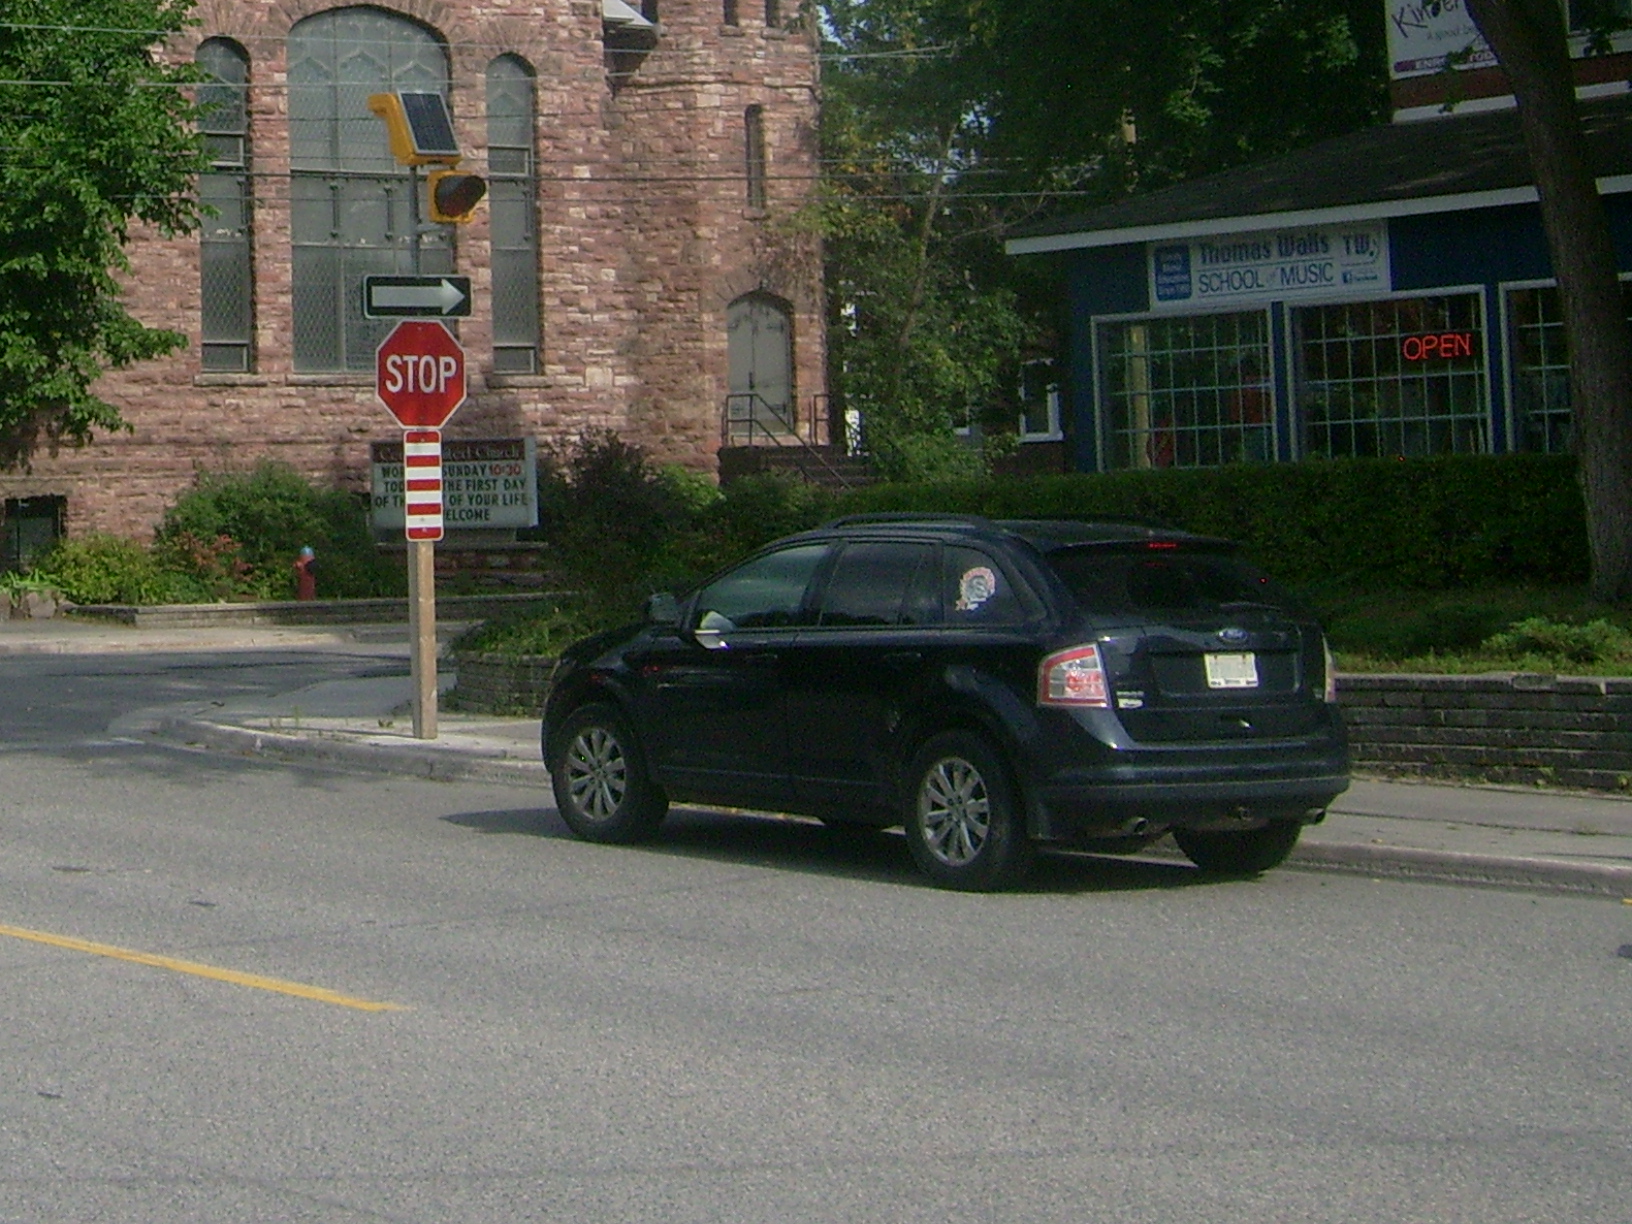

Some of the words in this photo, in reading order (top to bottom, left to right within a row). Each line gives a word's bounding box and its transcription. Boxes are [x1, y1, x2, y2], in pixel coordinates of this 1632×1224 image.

[1198, 268, 1265, 293] SCHOOL
[1280, 262, 1334, 286] MUSIC
[1402, 332, 1472, 361] OPEN
[385, 353, 458, 394] STOP
[442, 464, 487, 477] SUNDAY
[466, 478, 498, 491] FIRST
[503, 478, 526, 490] DAY
[374, 495, 389, 508] OF
[449, 494, 462, 507] OF
[467, 493, 499, 507] YOUR
[503, 493, 528, 506] LIFE
[444, 507, 490, 522] ELCOME
